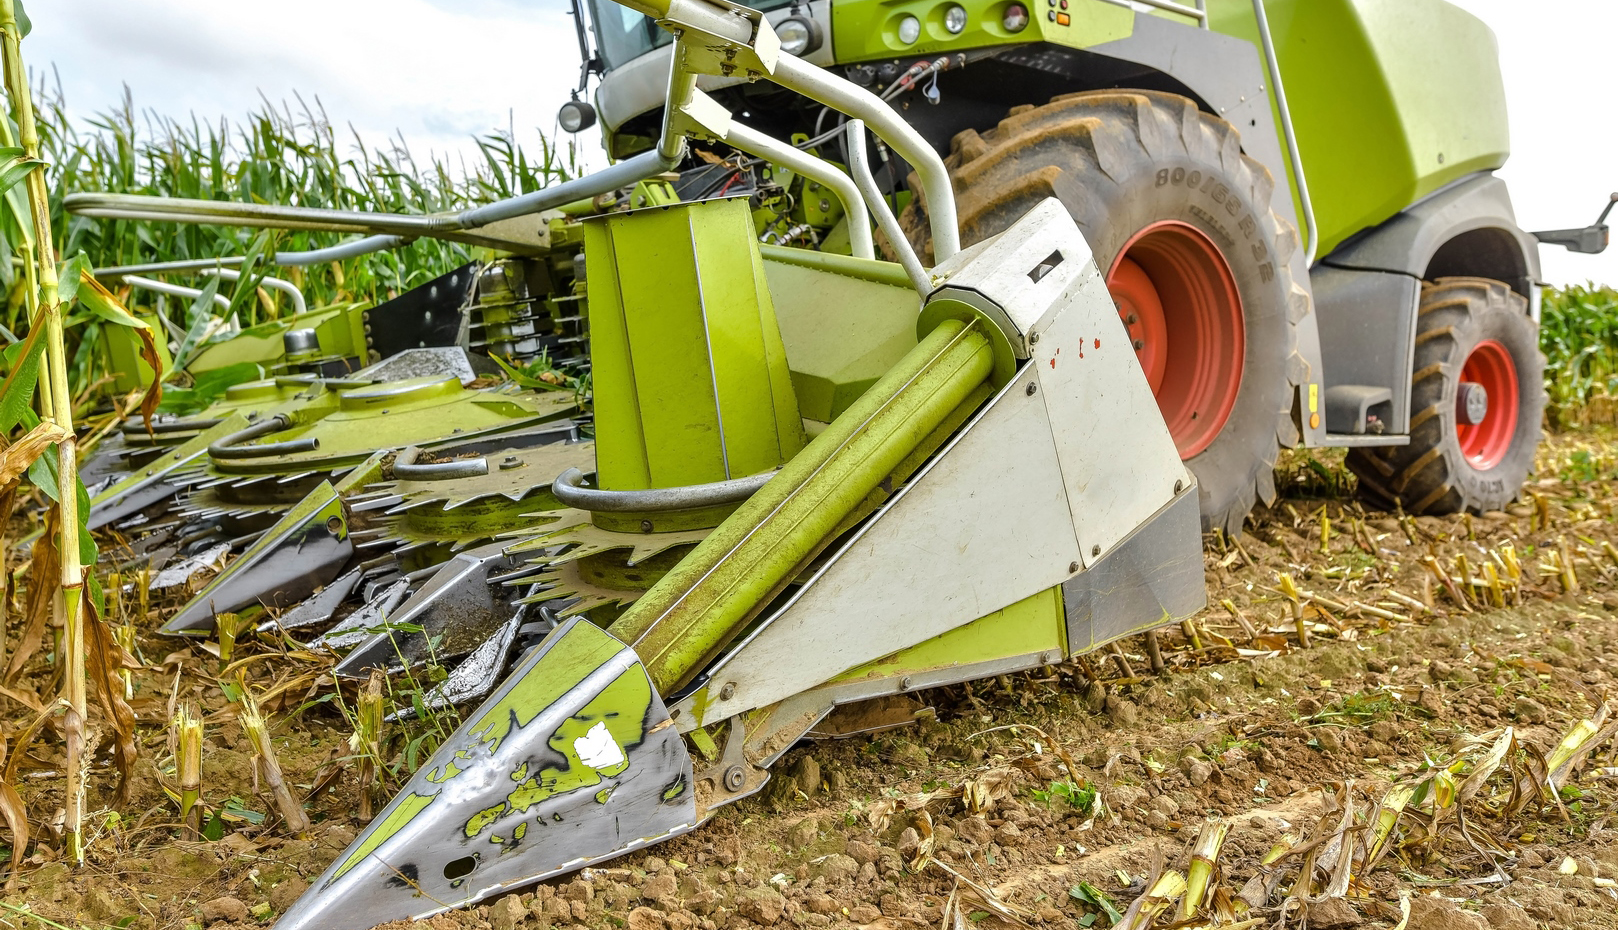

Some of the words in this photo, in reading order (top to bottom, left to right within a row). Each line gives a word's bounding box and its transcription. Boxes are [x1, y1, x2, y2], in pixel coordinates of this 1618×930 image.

[1155, 167, 1242, 217] 800/65
[1237, 214, 1256, 239] R
[1251, 239, 1274, 284] 32
